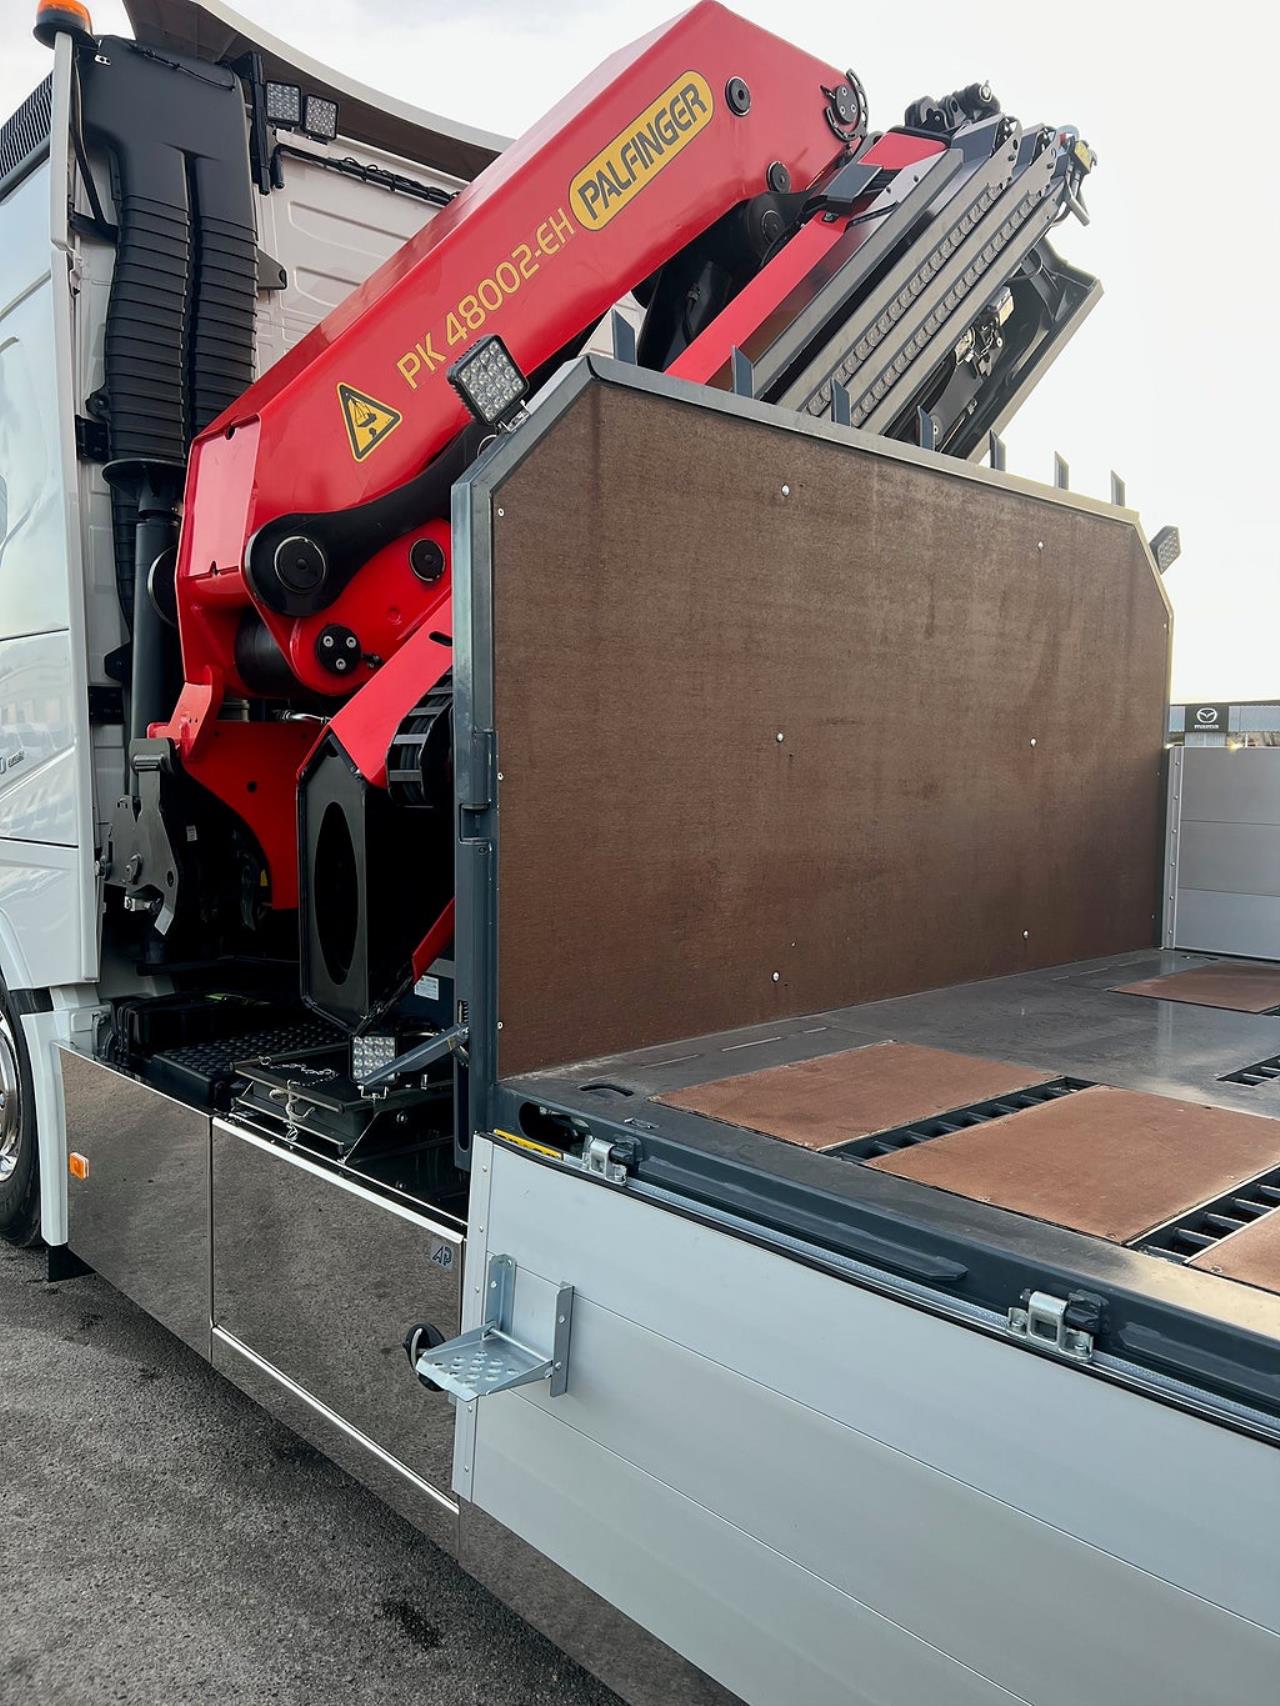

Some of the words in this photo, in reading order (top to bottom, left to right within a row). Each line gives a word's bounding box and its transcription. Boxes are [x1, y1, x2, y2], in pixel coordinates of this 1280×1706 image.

[578, 83, 706, 221] PALFINGER
[396, 333, 446, 389] PK
[444, 208, 574, 348] 48002-EH
